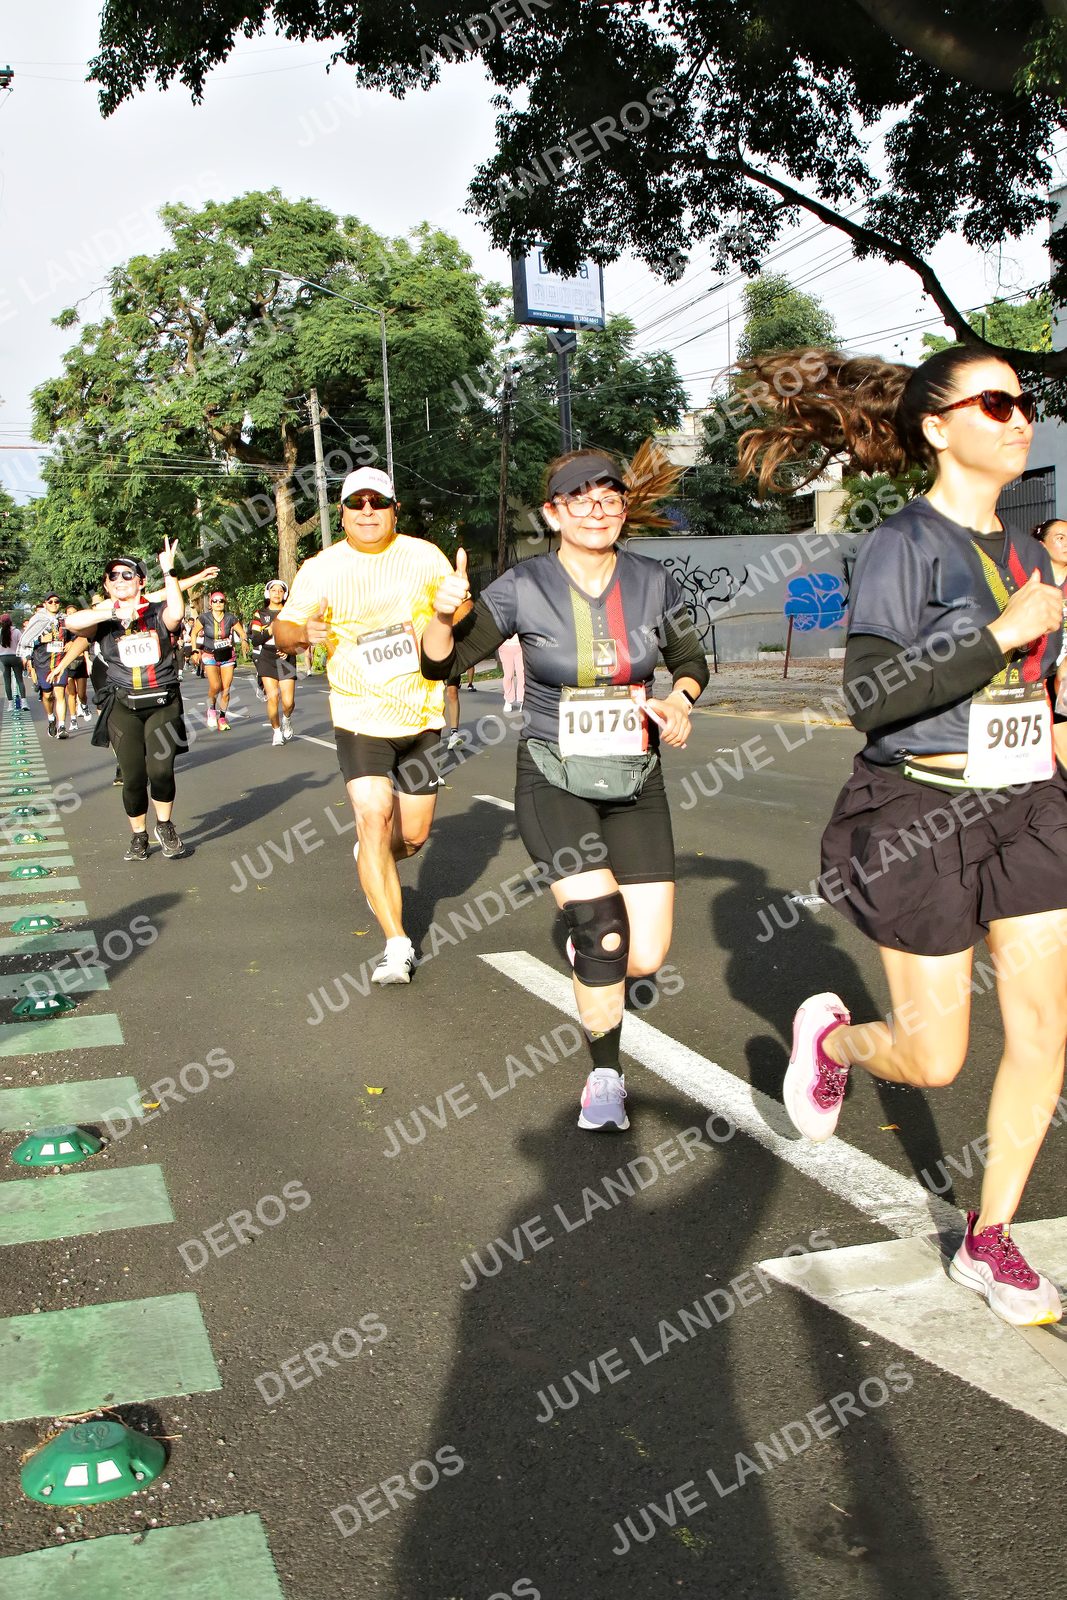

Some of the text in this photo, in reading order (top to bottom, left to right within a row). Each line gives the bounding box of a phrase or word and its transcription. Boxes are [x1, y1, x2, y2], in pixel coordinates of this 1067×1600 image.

[125, 642, 152, 656] 8165
[362, 638, 413, 665] 10660
[564, 708, 637, 734] 10176
[986, 713, 1043, 750] 9875
